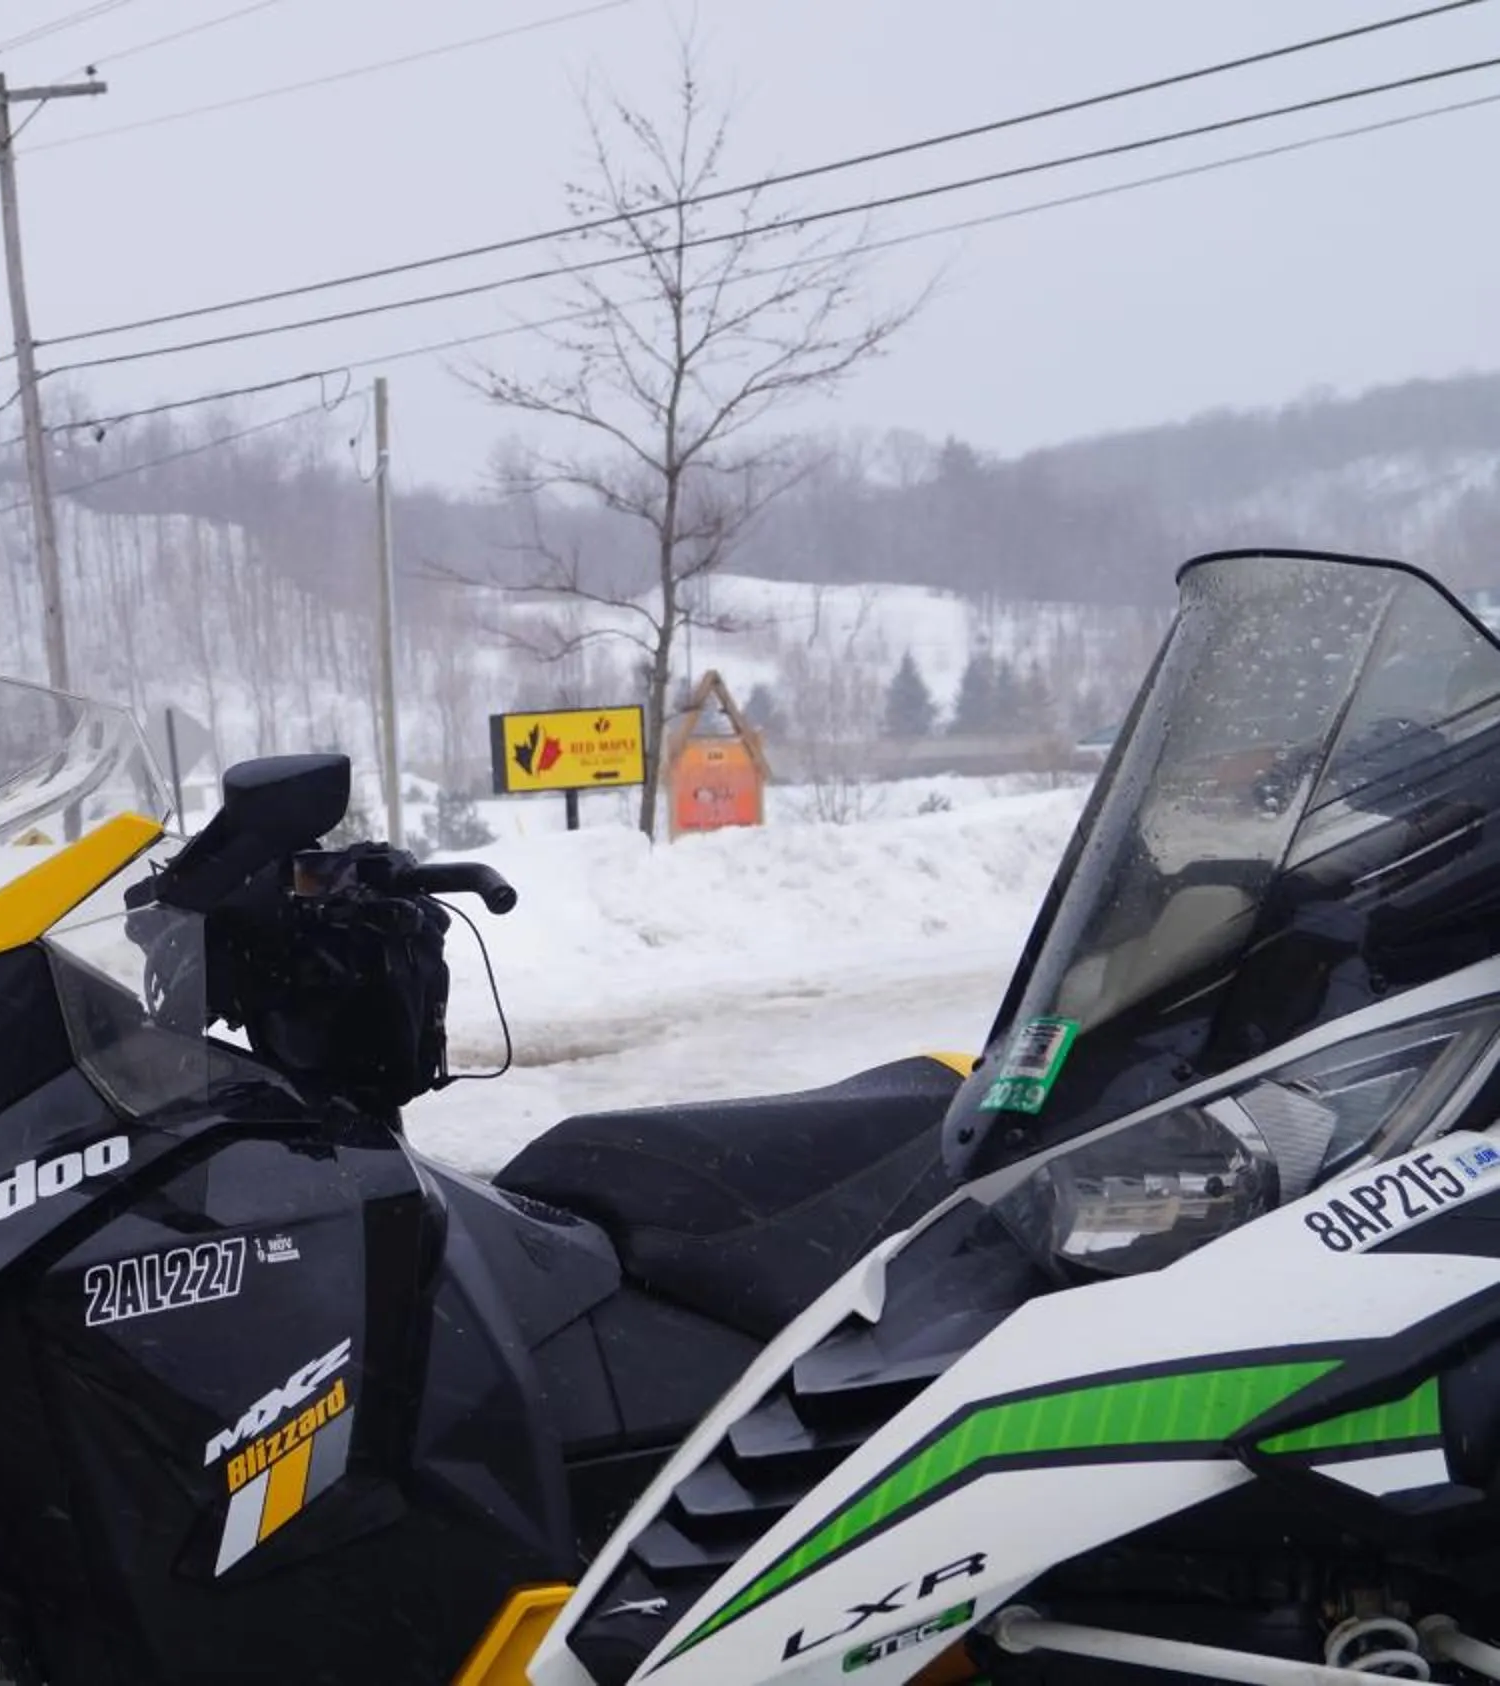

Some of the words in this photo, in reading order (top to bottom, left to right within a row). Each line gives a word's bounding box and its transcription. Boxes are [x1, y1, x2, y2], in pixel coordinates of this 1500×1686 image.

[1304, 1153, 1466, 1253] 8AP215
[84, 1237, 247, 1327] 2AL227
[227, 1377, 346, 1494] Blizzard
[781, 1552, 988, 1661] LXR
